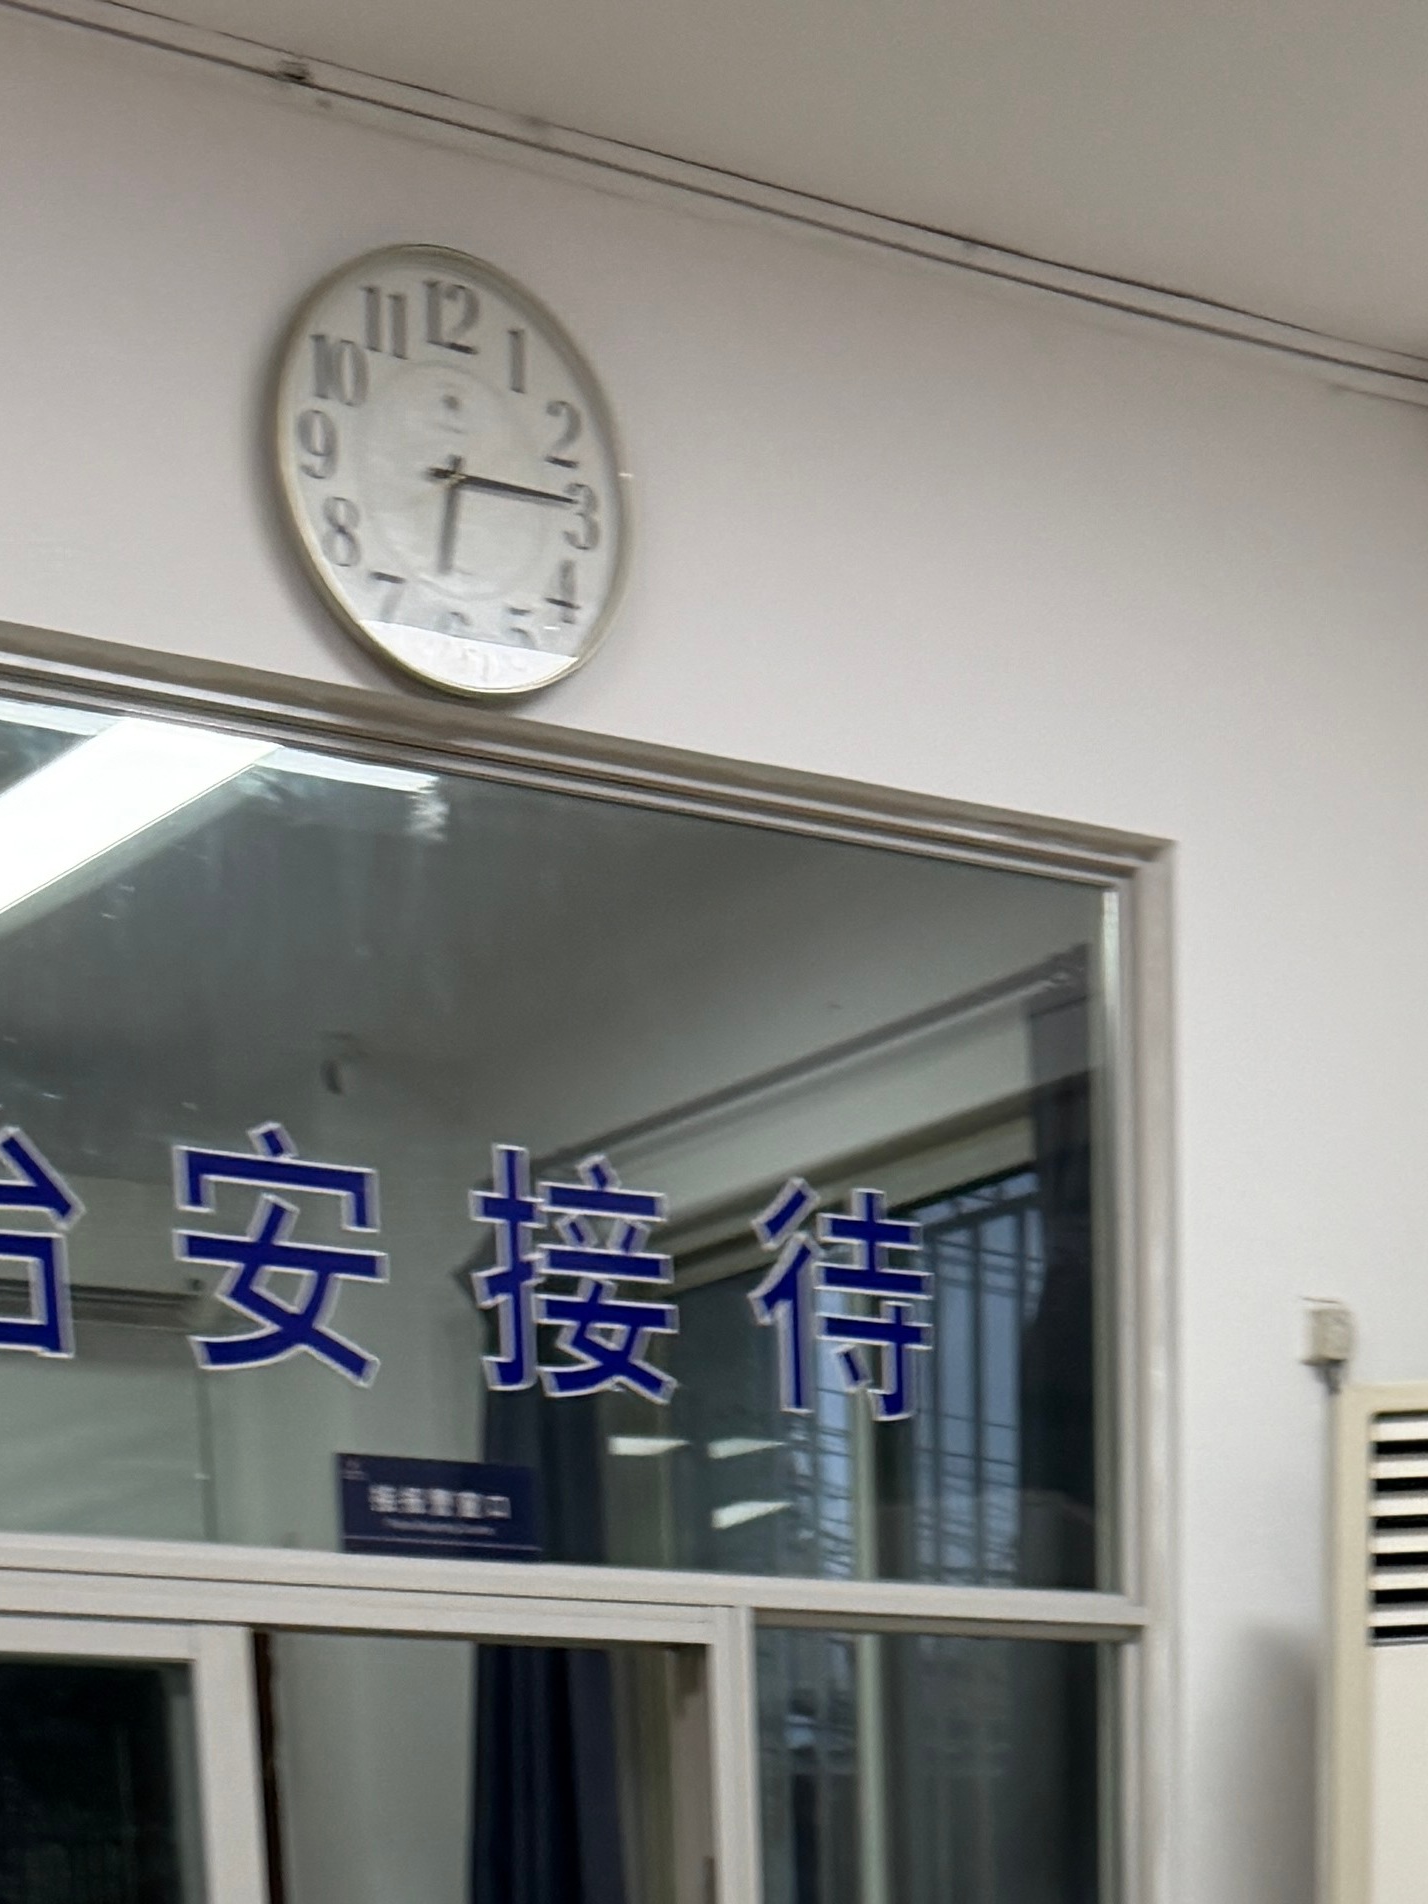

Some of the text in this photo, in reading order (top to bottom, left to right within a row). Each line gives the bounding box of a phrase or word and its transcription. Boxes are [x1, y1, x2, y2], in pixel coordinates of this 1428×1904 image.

[364, 286, 407, 360] 11
[423, 279, 479, 355] 12
[310, 334, 369, 407] 10
[507, 329, 528, 394] 1
[295, 410, 339, 480] 9
[544, 400, 582, 468] 2
[321, 497, 361, 567] 8
[561, 483, 599, 550] 3
[544, 560, 581, 625] 4
